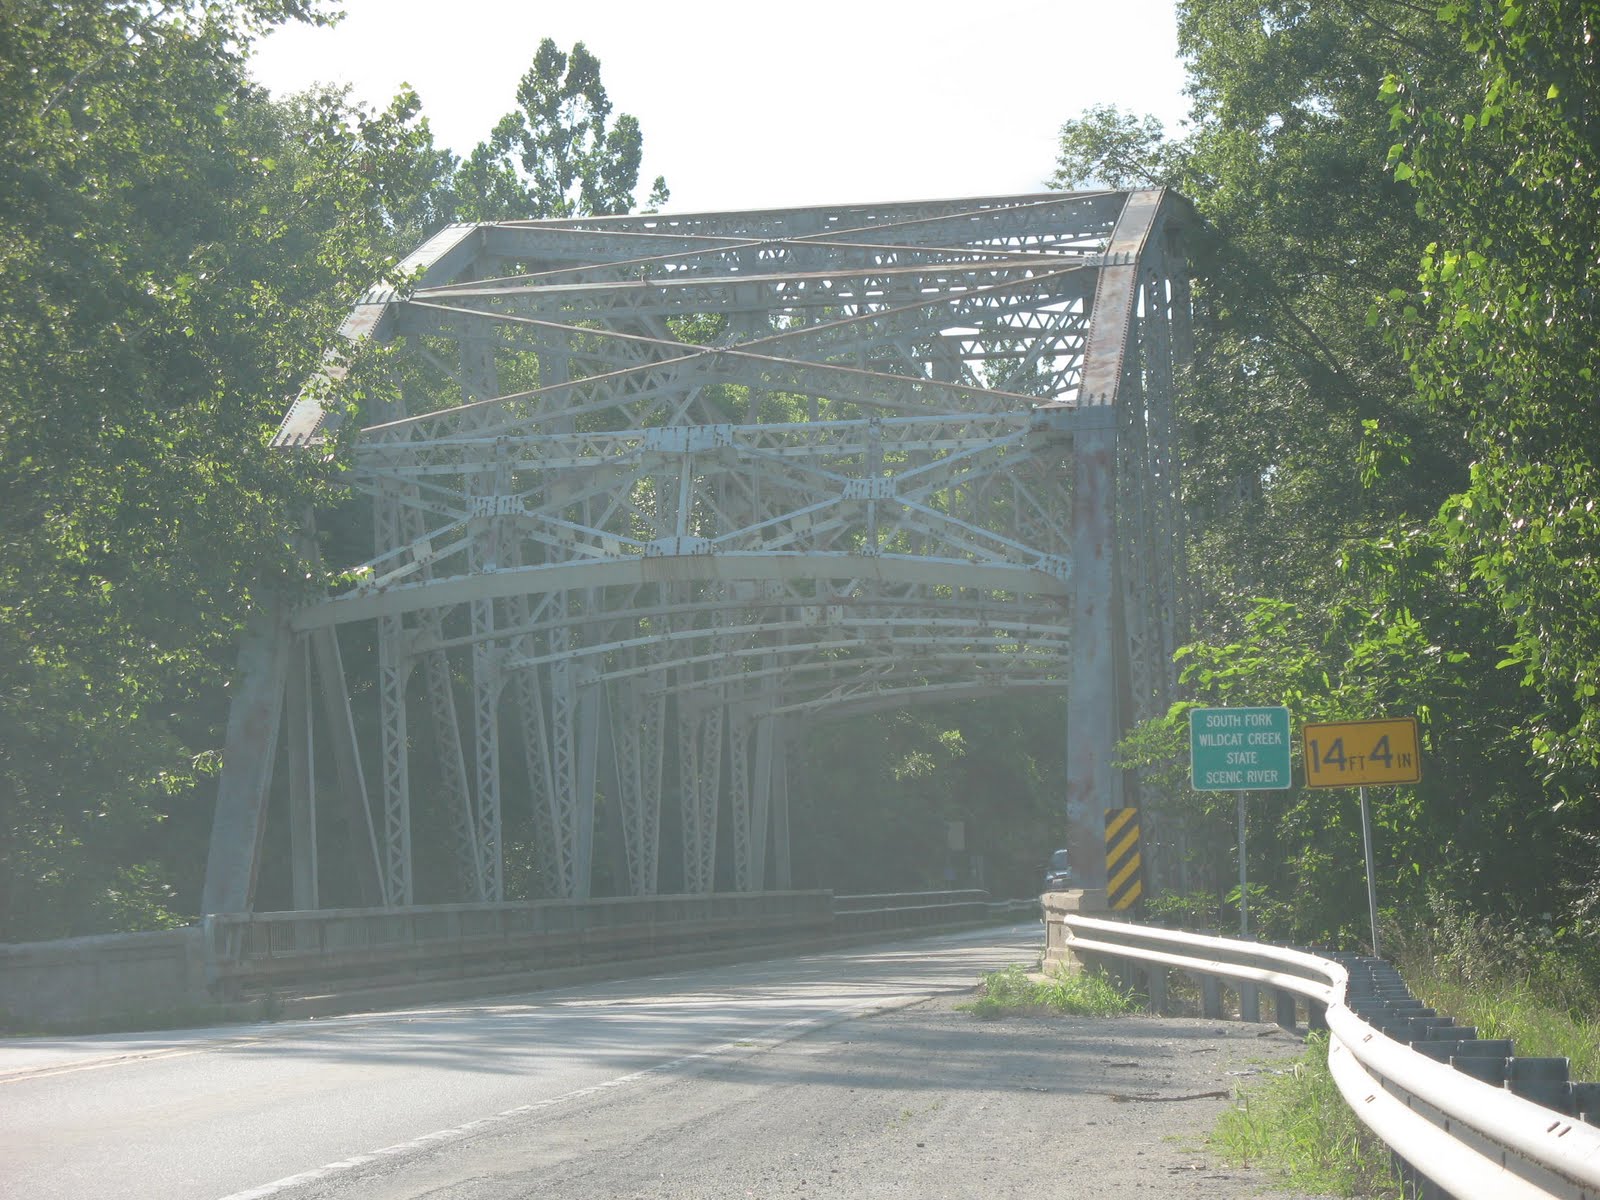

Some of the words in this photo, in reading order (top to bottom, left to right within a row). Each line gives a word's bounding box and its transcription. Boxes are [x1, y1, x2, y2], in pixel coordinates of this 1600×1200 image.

[1206, 714, 1241, 728] SOUTH
[1245, 713, 1273, 727] FORK
[1199, 733, 1243, 747] WILDCAT
[1248, 732, 1282, 745] CREEK
[1226, 751, 1258, 765] STATE
[1309, 736, 1347, 774] 14
[1349, 755, 1365, 771] FT
[1368, 734, 1394, 769] 4
[1397, 752, 1412, 769] IN
[1206, 771, 1243, 784] SCENIC
[1247, 770, 1278, 783] RIVER
